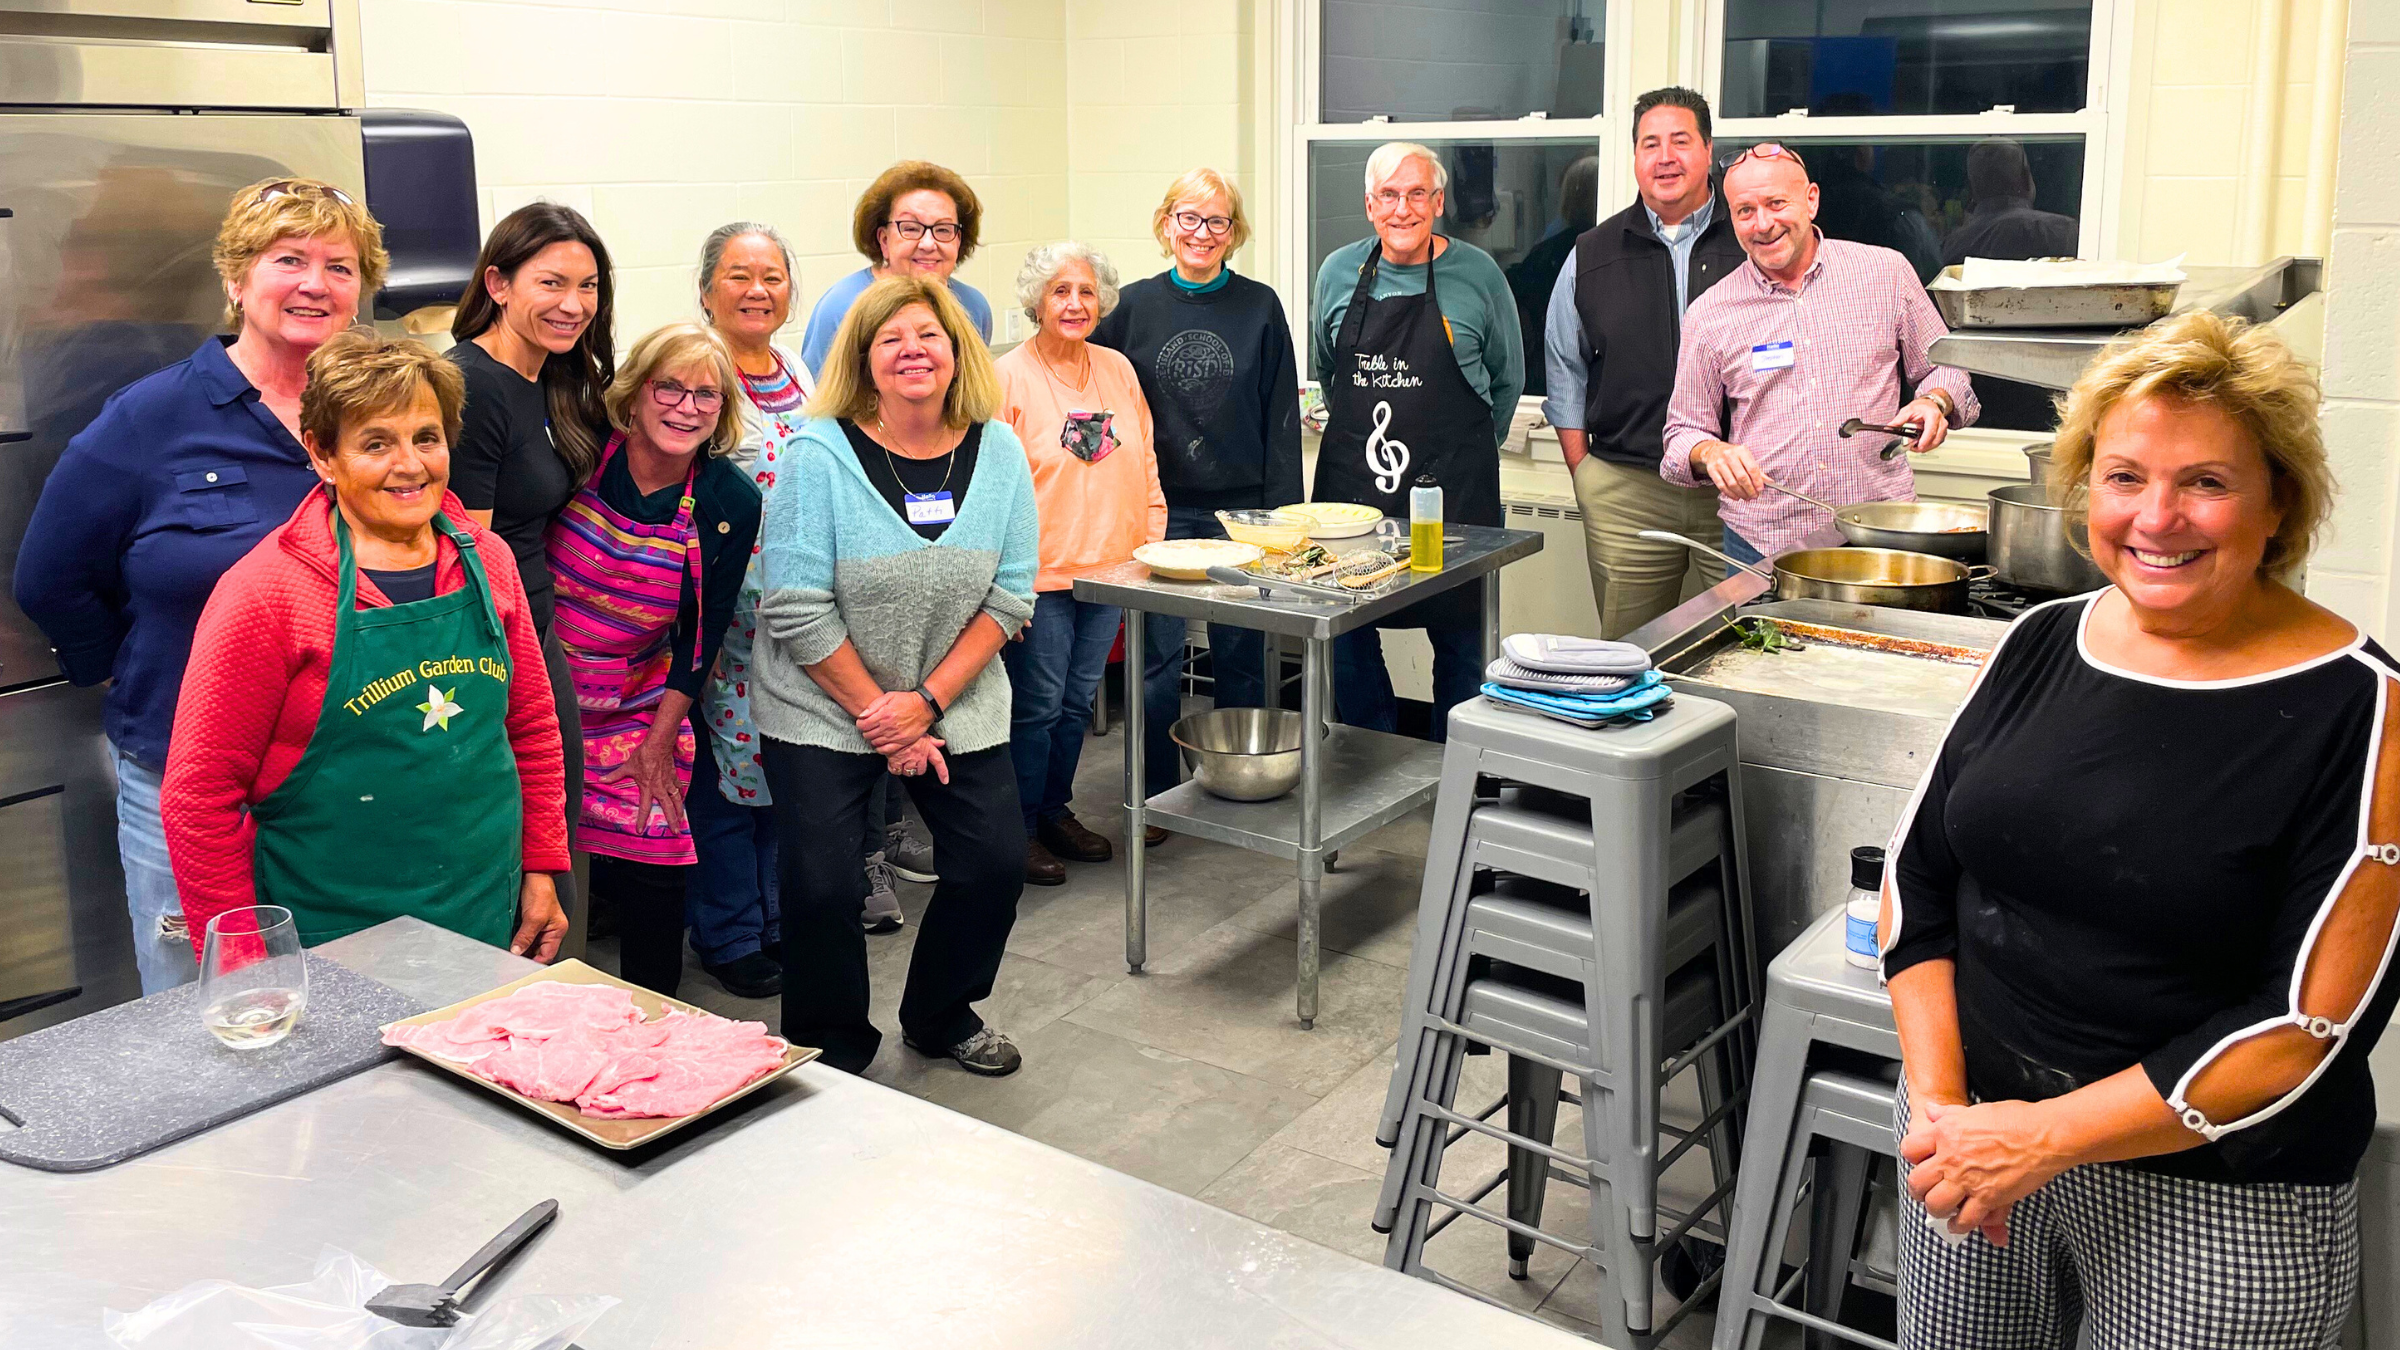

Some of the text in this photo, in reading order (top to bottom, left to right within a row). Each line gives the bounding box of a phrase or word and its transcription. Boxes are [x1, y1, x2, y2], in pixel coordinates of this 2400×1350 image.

[1160, 333, 1230, 367] ISLAND SCHOOL OF
[1354, 353, 1409, 370] Treble in
[1352, 371, 1368, 387] the
[343, 655, 507, 716] Trillium Garden Club
